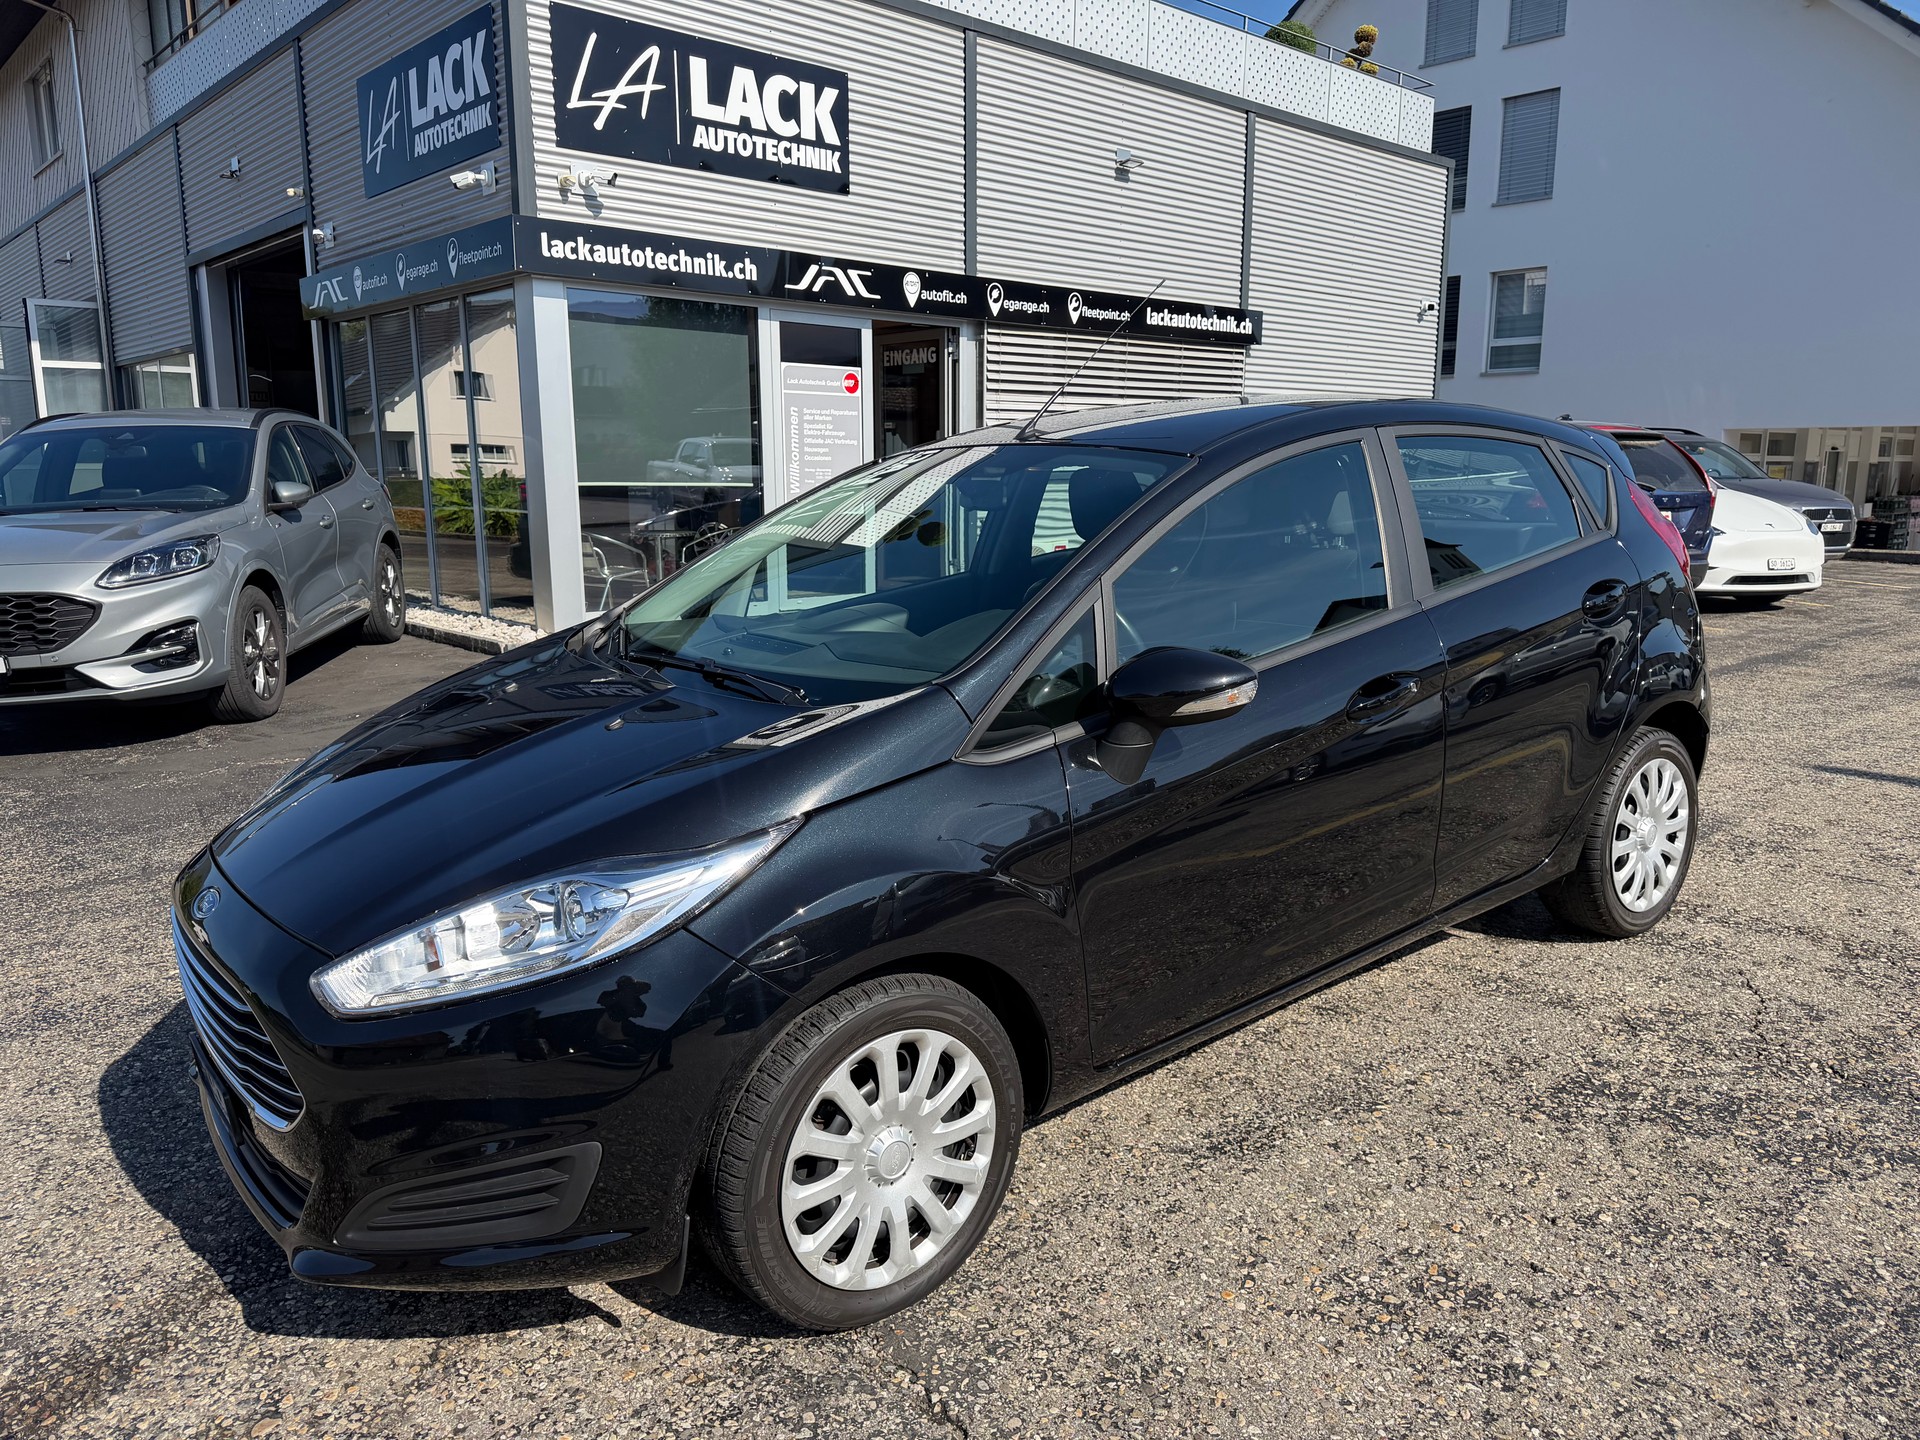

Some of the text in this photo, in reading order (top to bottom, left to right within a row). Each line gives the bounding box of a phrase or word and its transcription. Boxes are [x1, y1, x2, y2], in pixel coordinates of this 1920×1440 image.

[408, 28, 491, 129] LACK
[566, 31, 666, 131] LA
[688, 55, 841, 146] LACK
[366, 76, 401, 174] LA
[414, 101, 492, 158] AUTOTECHNIK
[692, 124, 842, 174] AUTOTECHNIK
[405, 259, 438, 281] egarage.ch
[458, 242, 502, 266] fleetpoint.ch
[540, 232, 758, 281] lackautotechnik.ch
[309, 276, 349, 310] JAC
[362, 274, 388, 291] autofit.ch
[784, 264, 882, 300] JAC
[920, 288, 967, 305] autofit.ch
[1003, 299, 1050, 314] egarage.ch
[1081, 304, 1131, 322] fleetpoint.ch
[1146, 307, 1253, 336] lackautotechnik.ch
[883, 347, 937, 367] EINGANG
[789, 406, 800, 493] Willkommen
